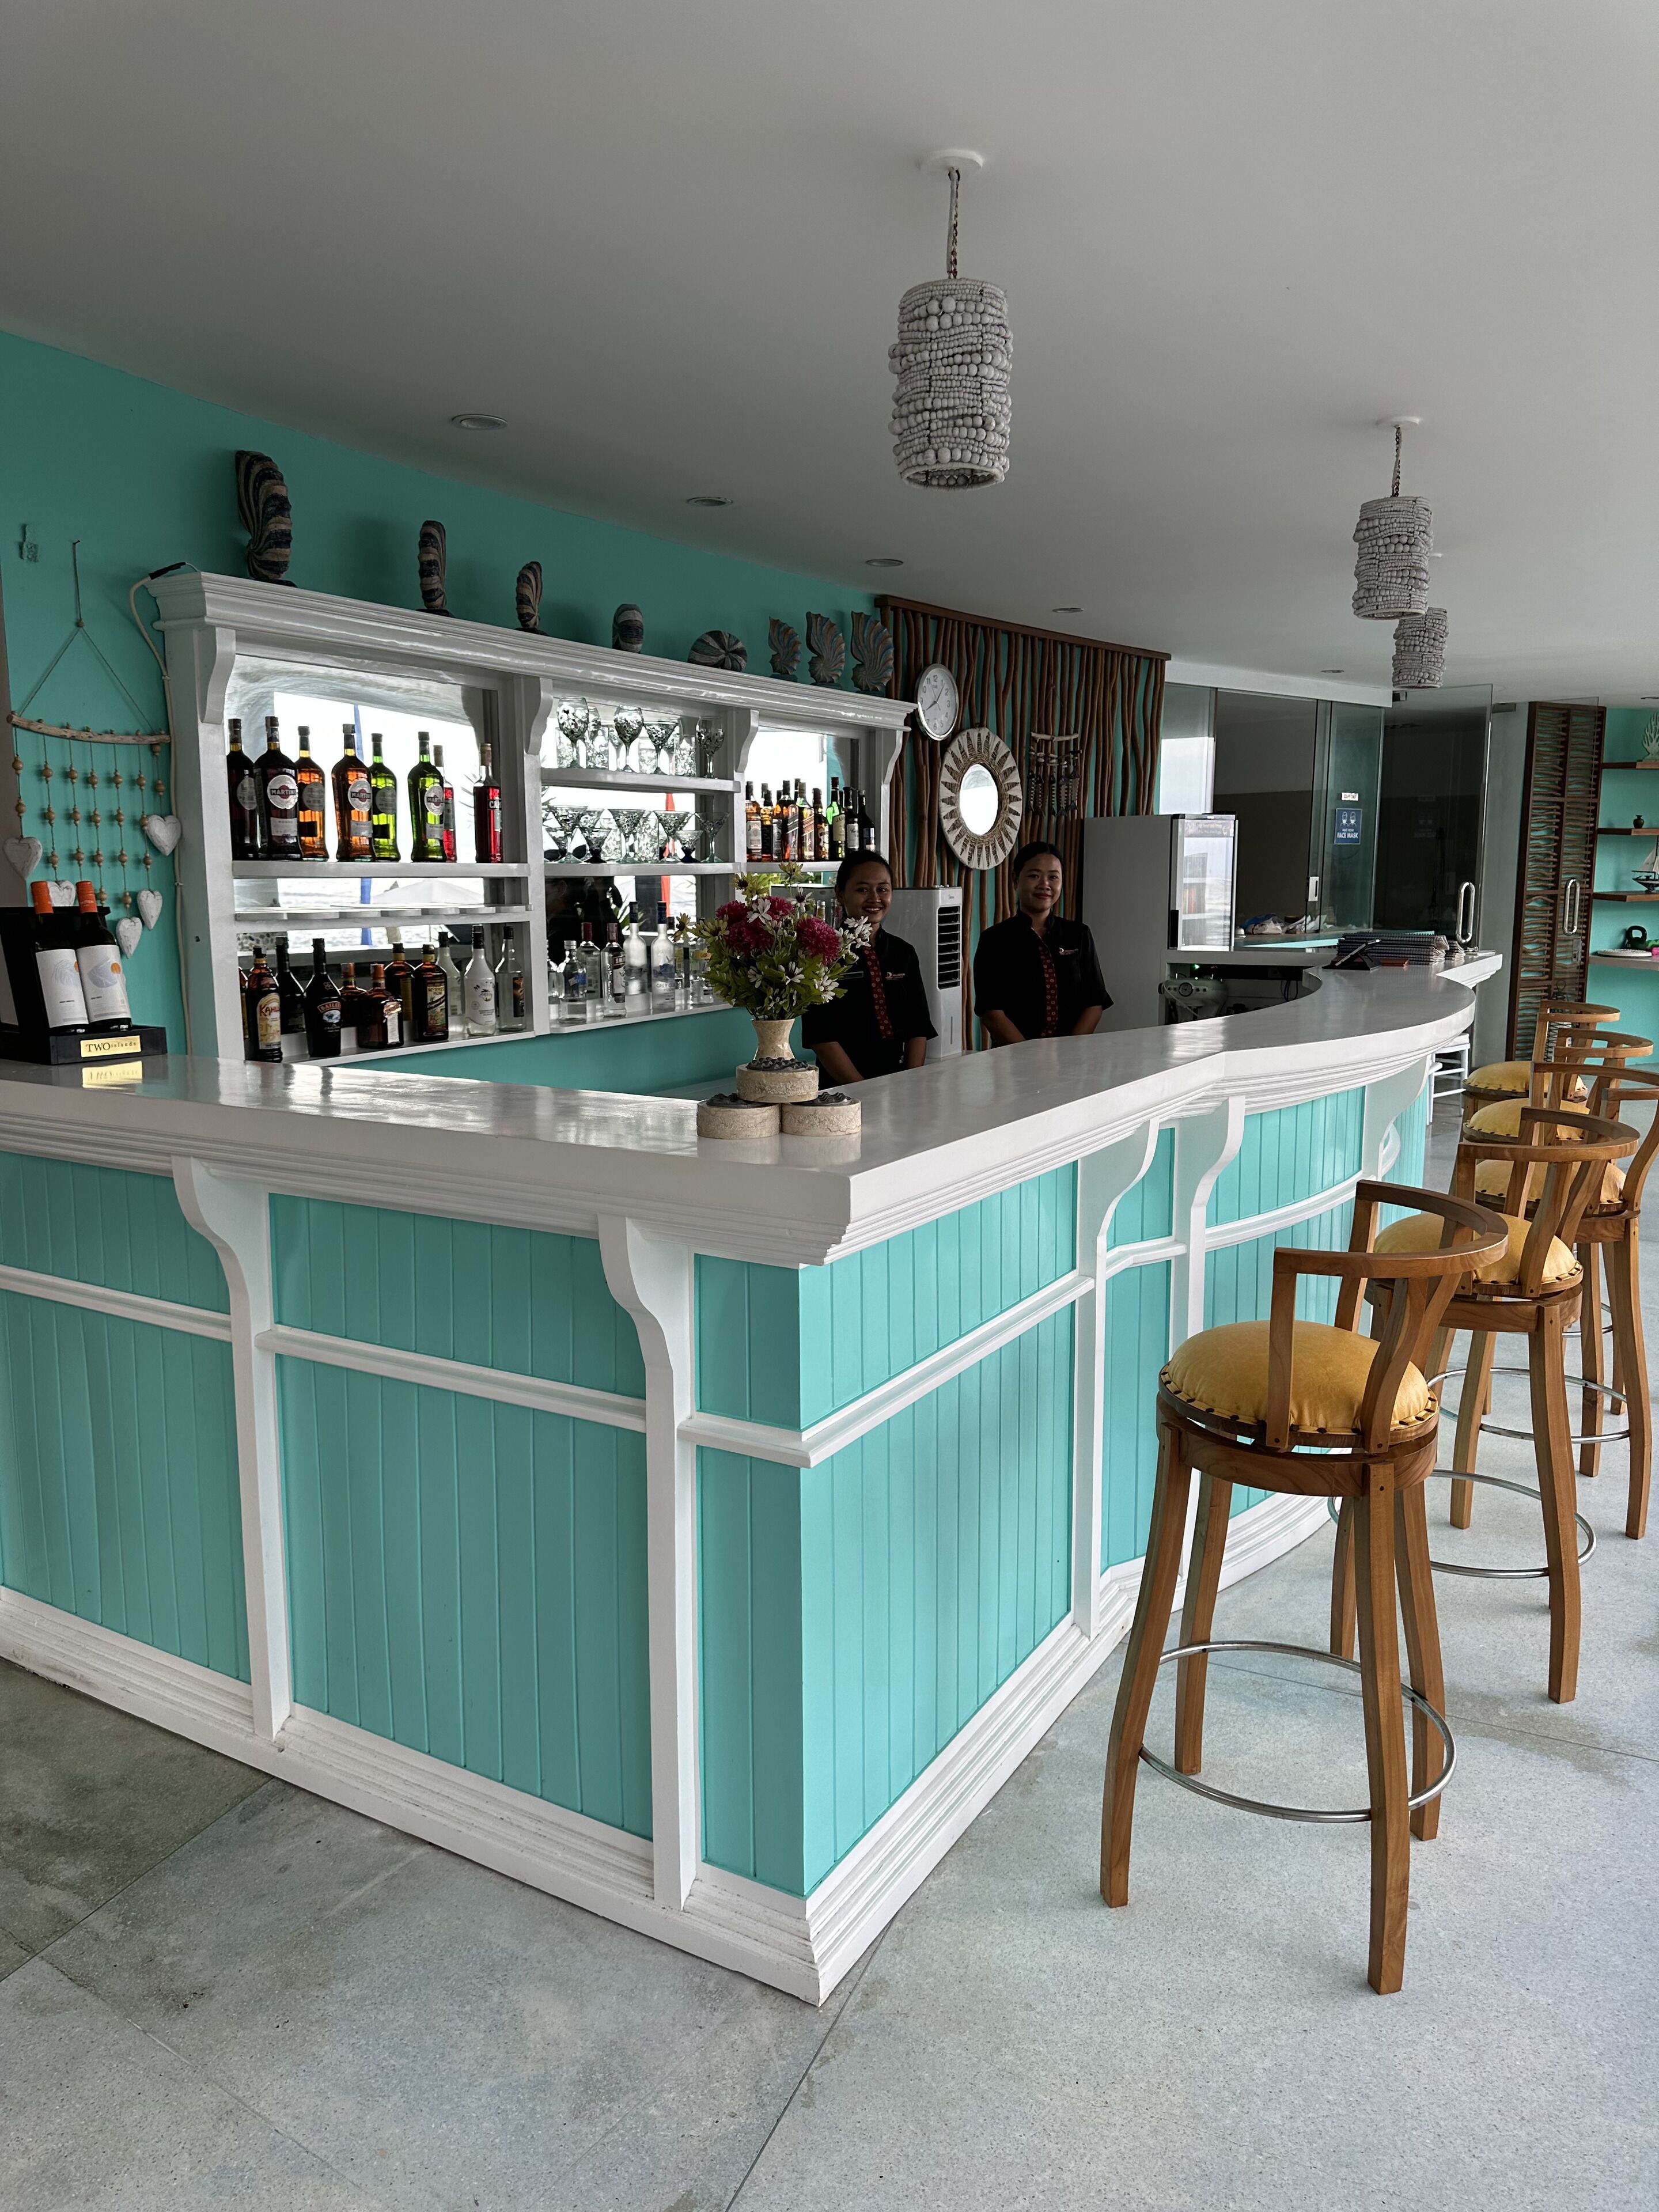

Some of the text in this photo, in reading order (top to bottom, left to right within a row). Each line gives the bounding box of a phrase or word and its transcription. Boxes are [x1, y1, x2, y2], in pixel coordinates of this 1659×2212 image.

[945, 688, 949, 696] 2
[940, 720, 944, 728] 5
[85, 1042, 111, 1052] TWO
